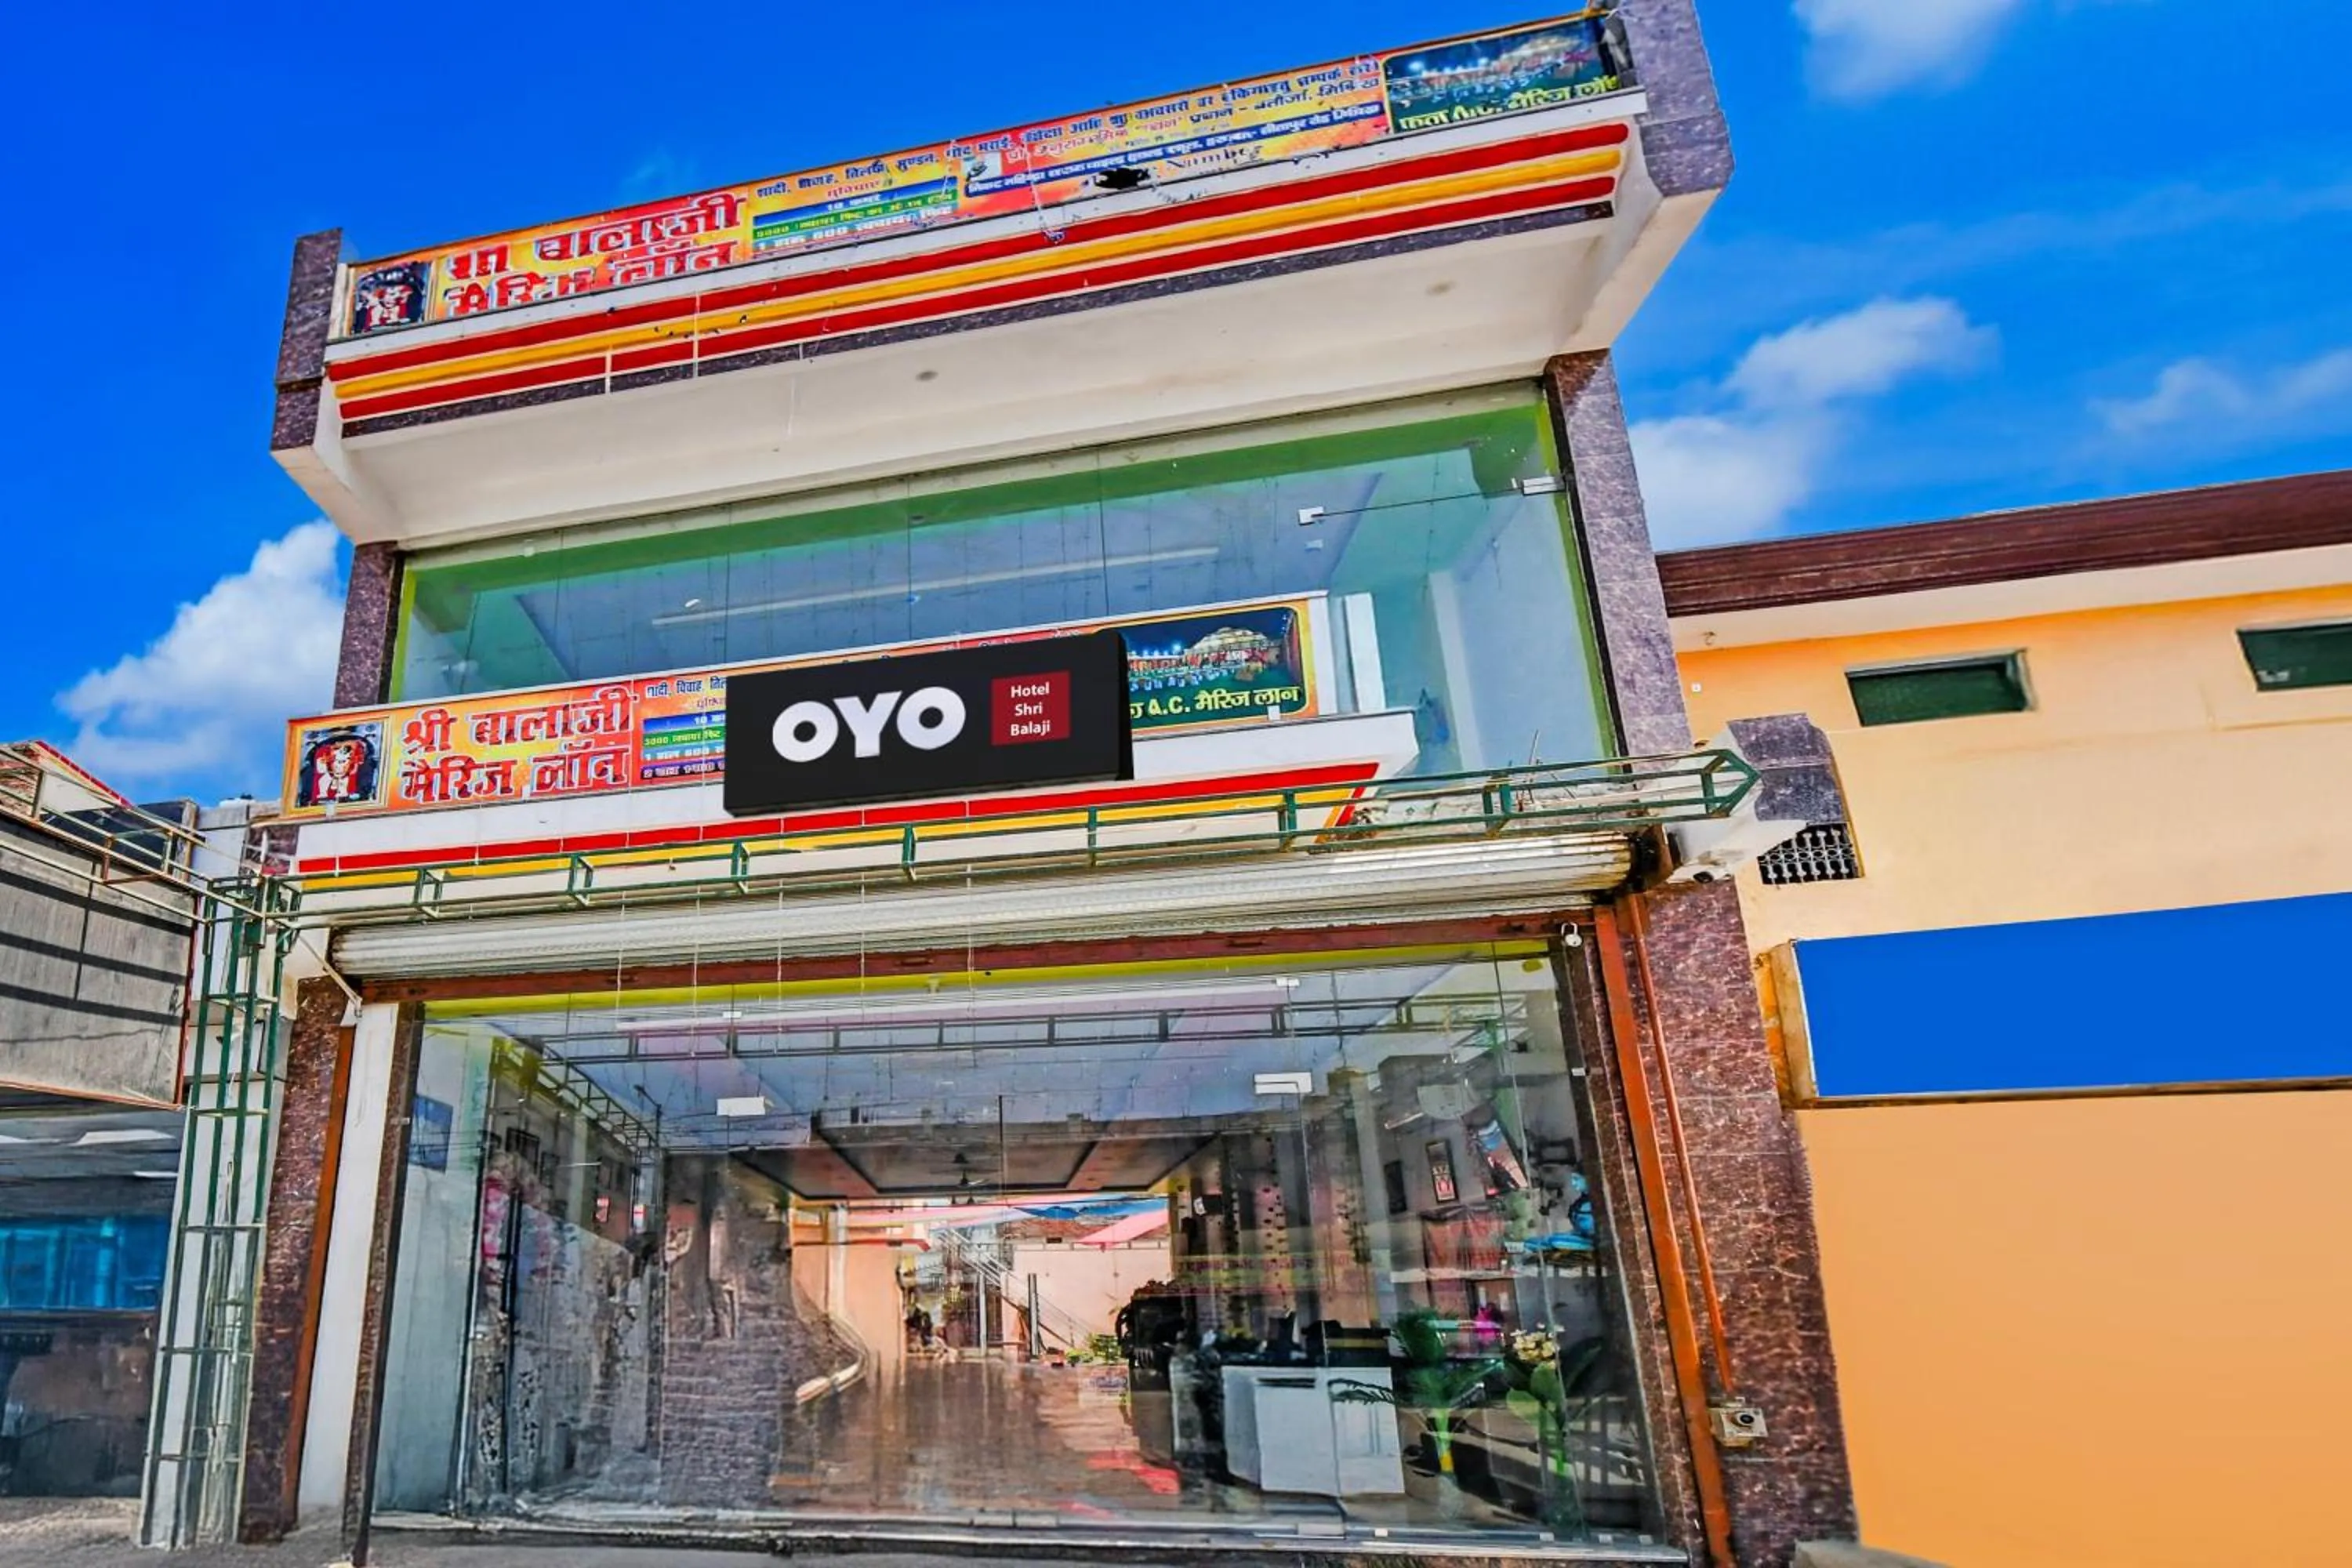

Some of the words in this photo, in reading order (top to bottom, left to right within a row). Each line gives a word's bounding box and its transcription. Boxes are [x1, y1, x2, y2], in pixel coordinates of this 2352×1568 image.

[1010, 681, 1050, 698] Hotel
[1148, 695, 1190, 716] A.C.
[1194, 688, 1250, 712] मैरिज
[401, 706, 457, 754] श्री
[469, 685, 640, 747] बालाजी
[1014, 702, 1043, 717] Shri
[771, 685, 967, 763] OYO
[1010, 720, 1051, 737] Balaji
[400, 755, 518, 806] मैरिज
[529, 739, 633, 794] लॉन
